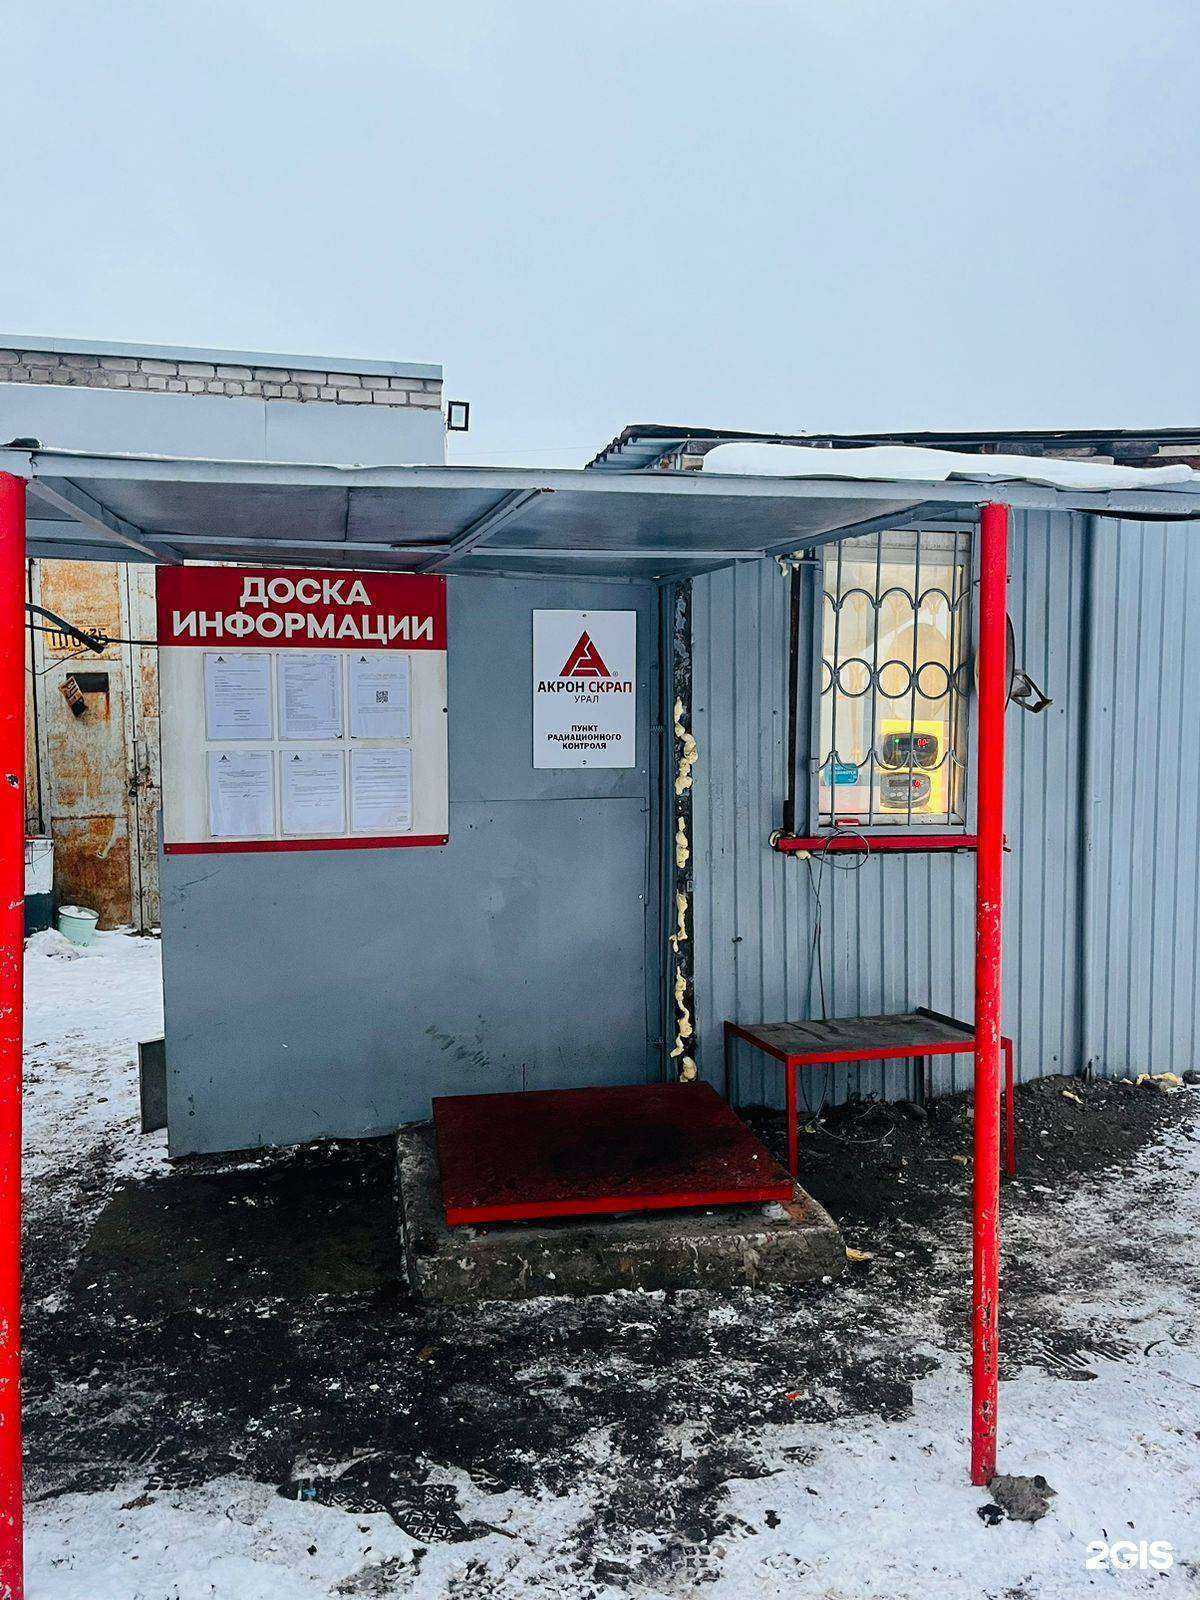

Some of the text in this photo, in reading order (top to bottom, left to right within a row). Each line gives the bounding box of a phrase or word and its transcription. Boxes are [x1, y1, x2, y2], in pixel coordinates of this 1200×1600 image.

[239, 576, 372, 608] ДОСКА
[172, 610, 434, 645] ИНФОРМАЦИИ
[537, 681, 633, 693] АКРОН СКРАП
[574, 695, 599, 704] УРАЛ
[571, 724, 599, 732] ПУНКТ
[547, 733, 622, 742] РАДИАЦИОННОГО
[562, 742, 607, 750] КОНТРОЛЯ
